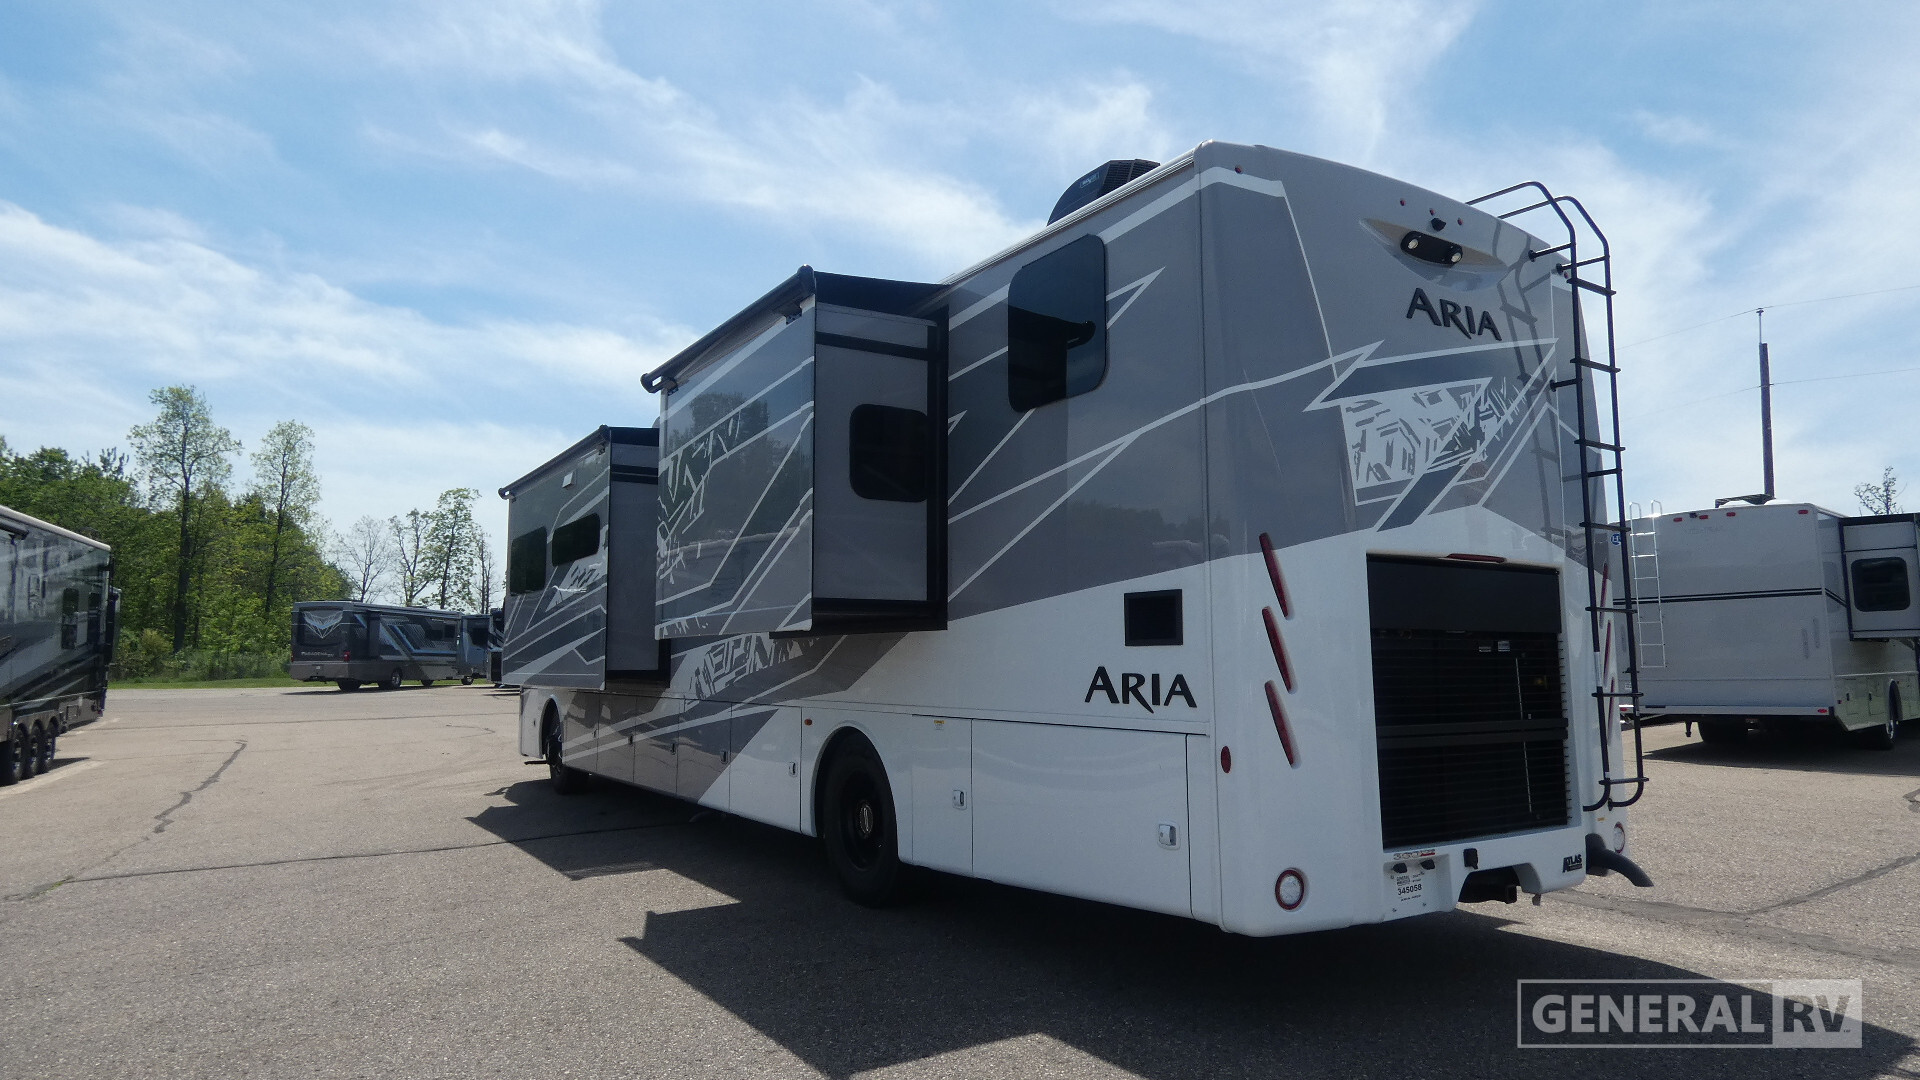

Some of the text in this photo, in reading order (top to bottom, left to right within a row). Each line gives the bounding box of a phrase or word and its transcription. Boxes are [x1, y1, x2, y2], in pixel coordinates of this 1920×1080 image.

[1406, 288, 1502, 341] ARIA
[1084, 666, 1197, 713] ARIA
[1562, 854, 1582, 873] ATLAS
[1397, 883, 1423, 896] 345058
